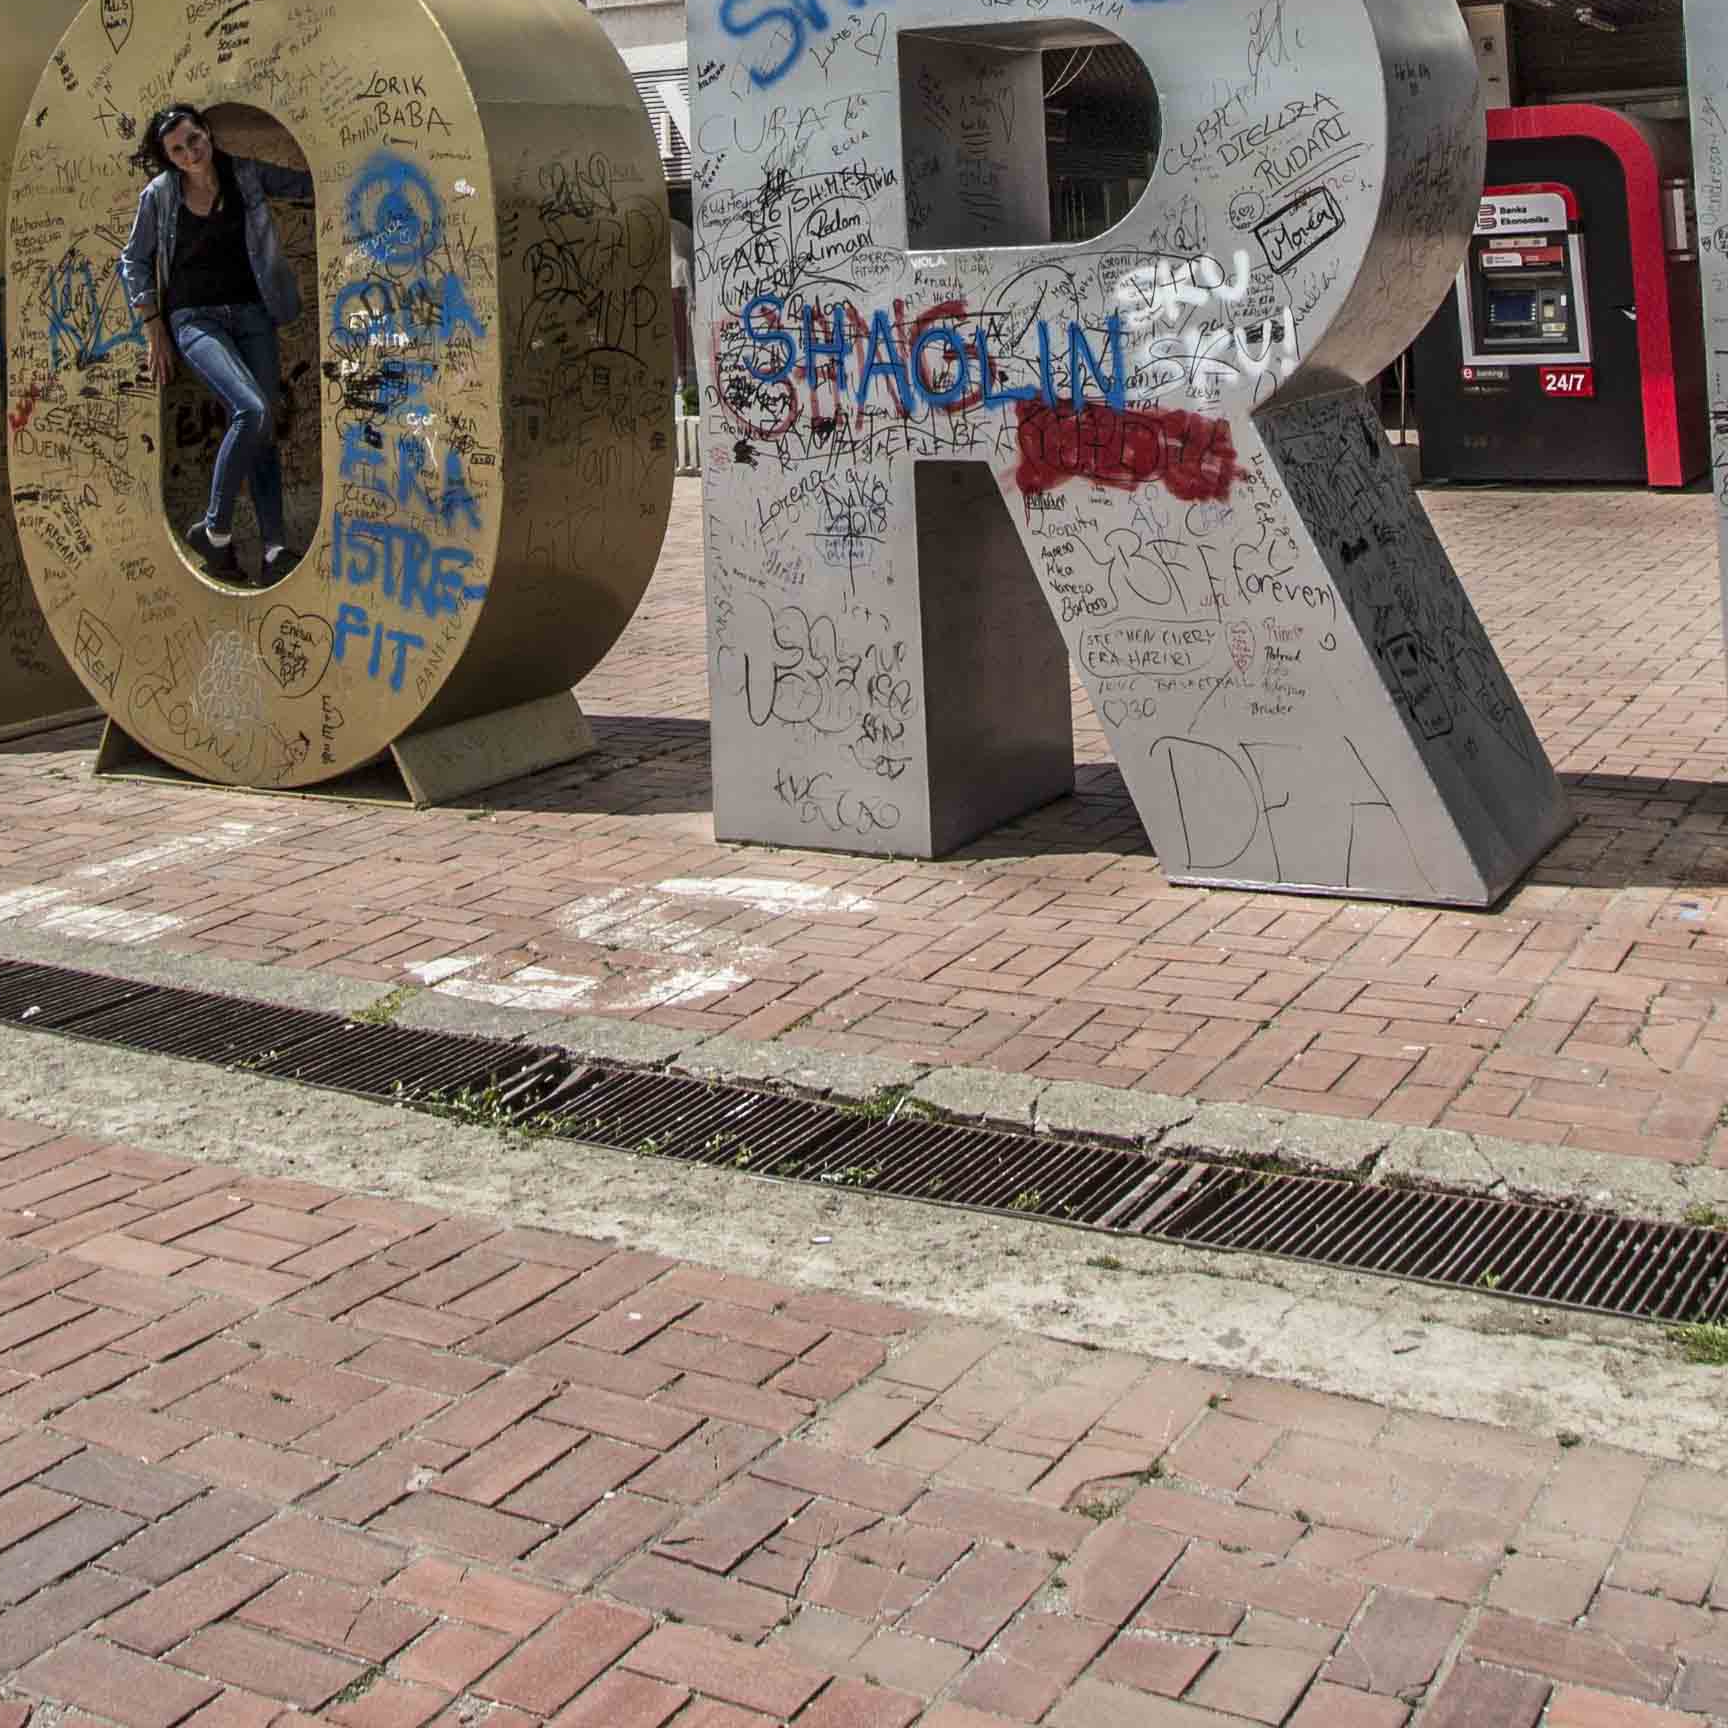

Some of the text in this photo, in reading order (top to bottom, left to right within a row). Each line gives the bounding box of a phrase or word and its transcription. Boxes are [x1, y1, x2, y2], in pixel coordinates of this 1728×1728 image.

[352, 71, 426, 101] LORIK
[374, 101, 454, 137] BABA
[1254, 111, 1353, 192] RUDARI
[1499, 207, 1527, 215] Banka
[1500, 216, 1550, 226] Ekonomike
[742, 291, 1126, 415] SHAOLIN
[1545, 373, 1585, 392] 24/7
